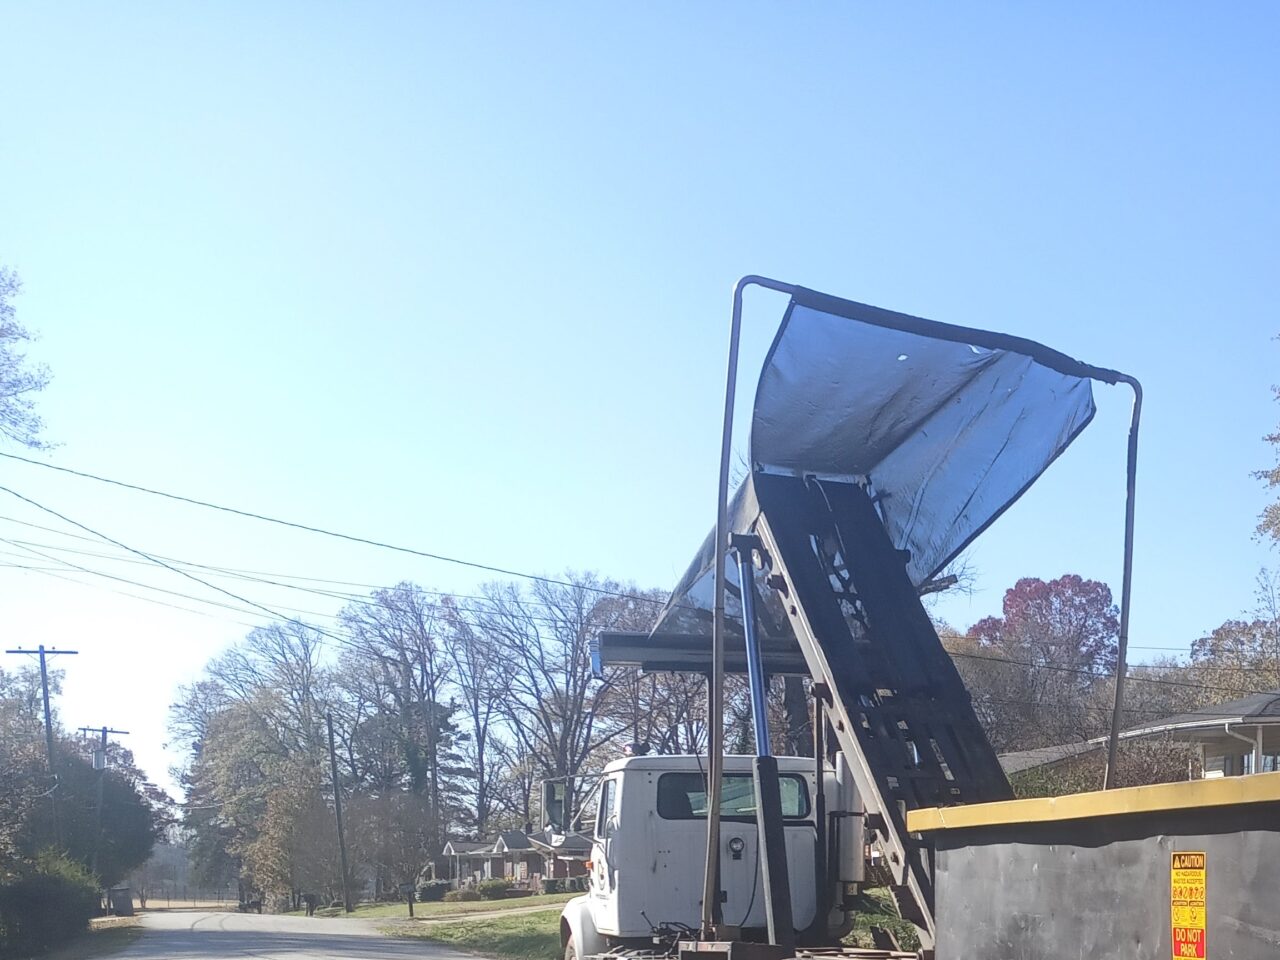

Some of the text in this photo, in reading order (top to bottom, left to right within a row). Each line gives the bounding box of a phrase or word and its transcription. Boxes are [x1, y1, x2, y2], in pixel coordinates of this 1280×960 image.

[1180, 855, 1204, 868] CAUTION
[1175, 928, 1202, 943] DO NOT
[1180, 943, 1198, 958] PARK
